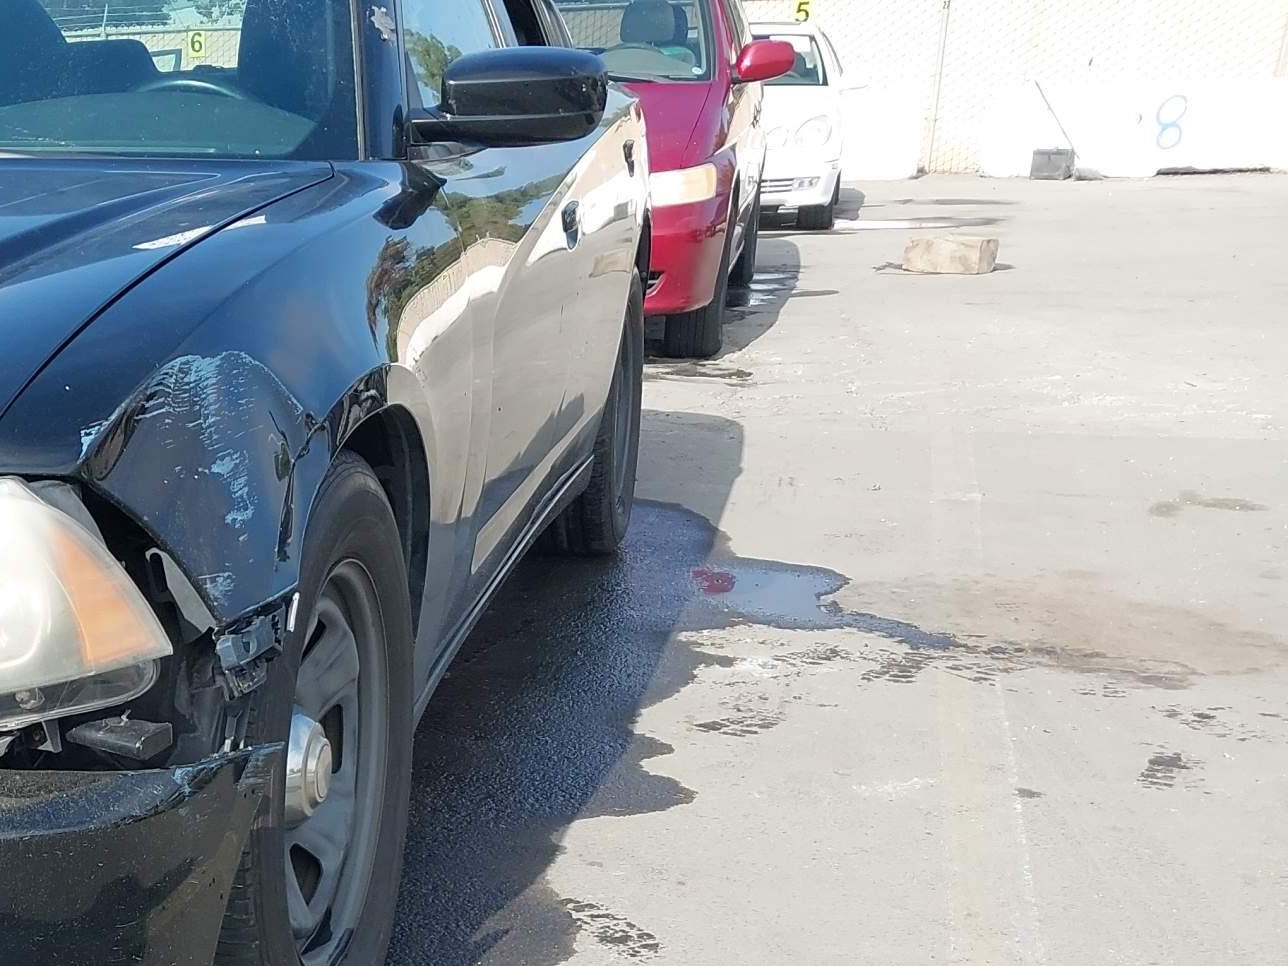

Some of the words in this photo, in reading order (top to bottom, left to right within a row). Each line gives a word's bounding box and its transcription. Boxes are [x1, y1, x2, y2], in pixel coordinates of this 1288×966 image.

[794, 0, 810, 23] 5
[191, 31, 203, 53] 6
[1155, 94, 1189, 151] 8
